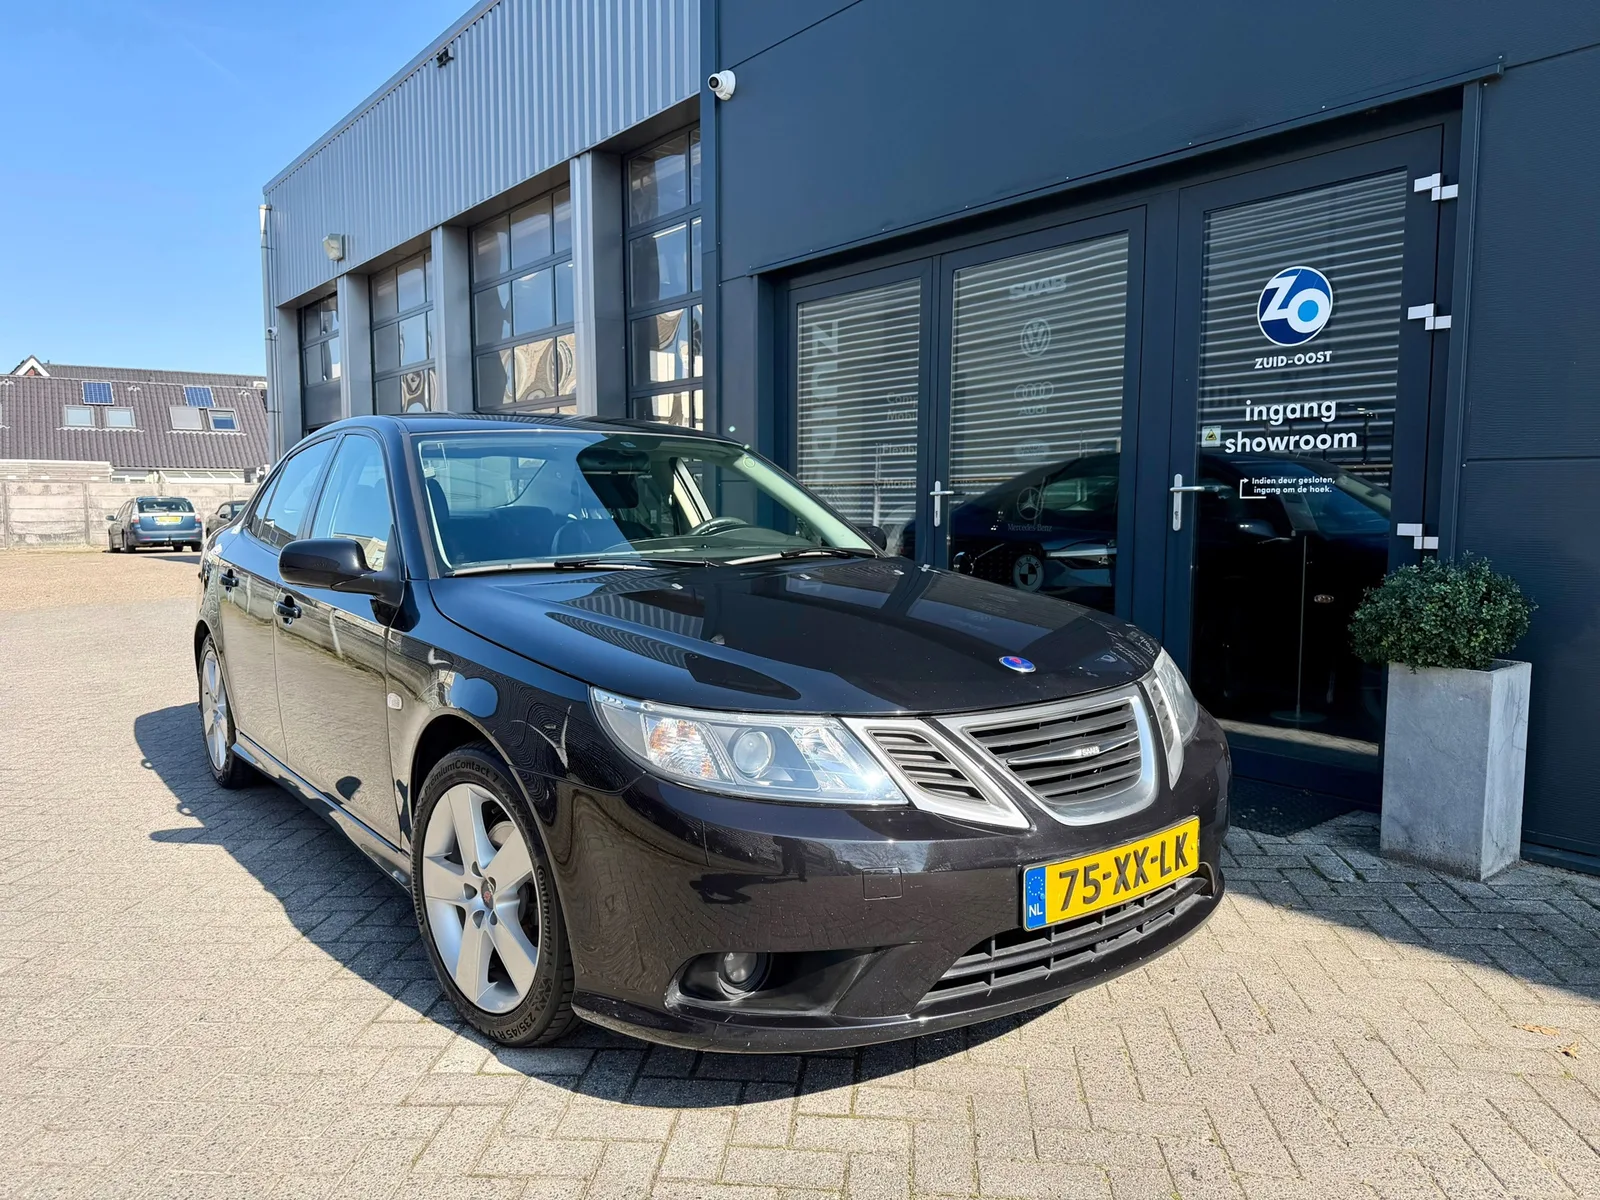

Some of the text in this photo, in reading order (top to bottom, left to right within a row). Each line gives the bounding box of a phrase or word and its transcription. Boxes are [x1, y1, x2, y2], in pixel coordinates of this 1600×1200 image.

[1008, 275, 1067, 300] SAAB
[1254, 350, 1332, 369] ZUID-OOST
[1245, 400, 1337, 425] ingang
[1225, 431, 1357, 453] showroom
[1253, 486, 1281, 495] ingang
[1309, 485, 1333, 493] hoek.
[1298, 476, 1336, 486] gesloten,
[1007, 523, 1053, 532] Mercedes-Benz
[424, 760, 491, 796] PremiumContact
[1059, 832, 1189, 912] 75-XX-LK
[536, 864, 553, 957] Continental
[1028, 904, 1043, 917] NL
[506, 1012, 536, 1039] 235/45
